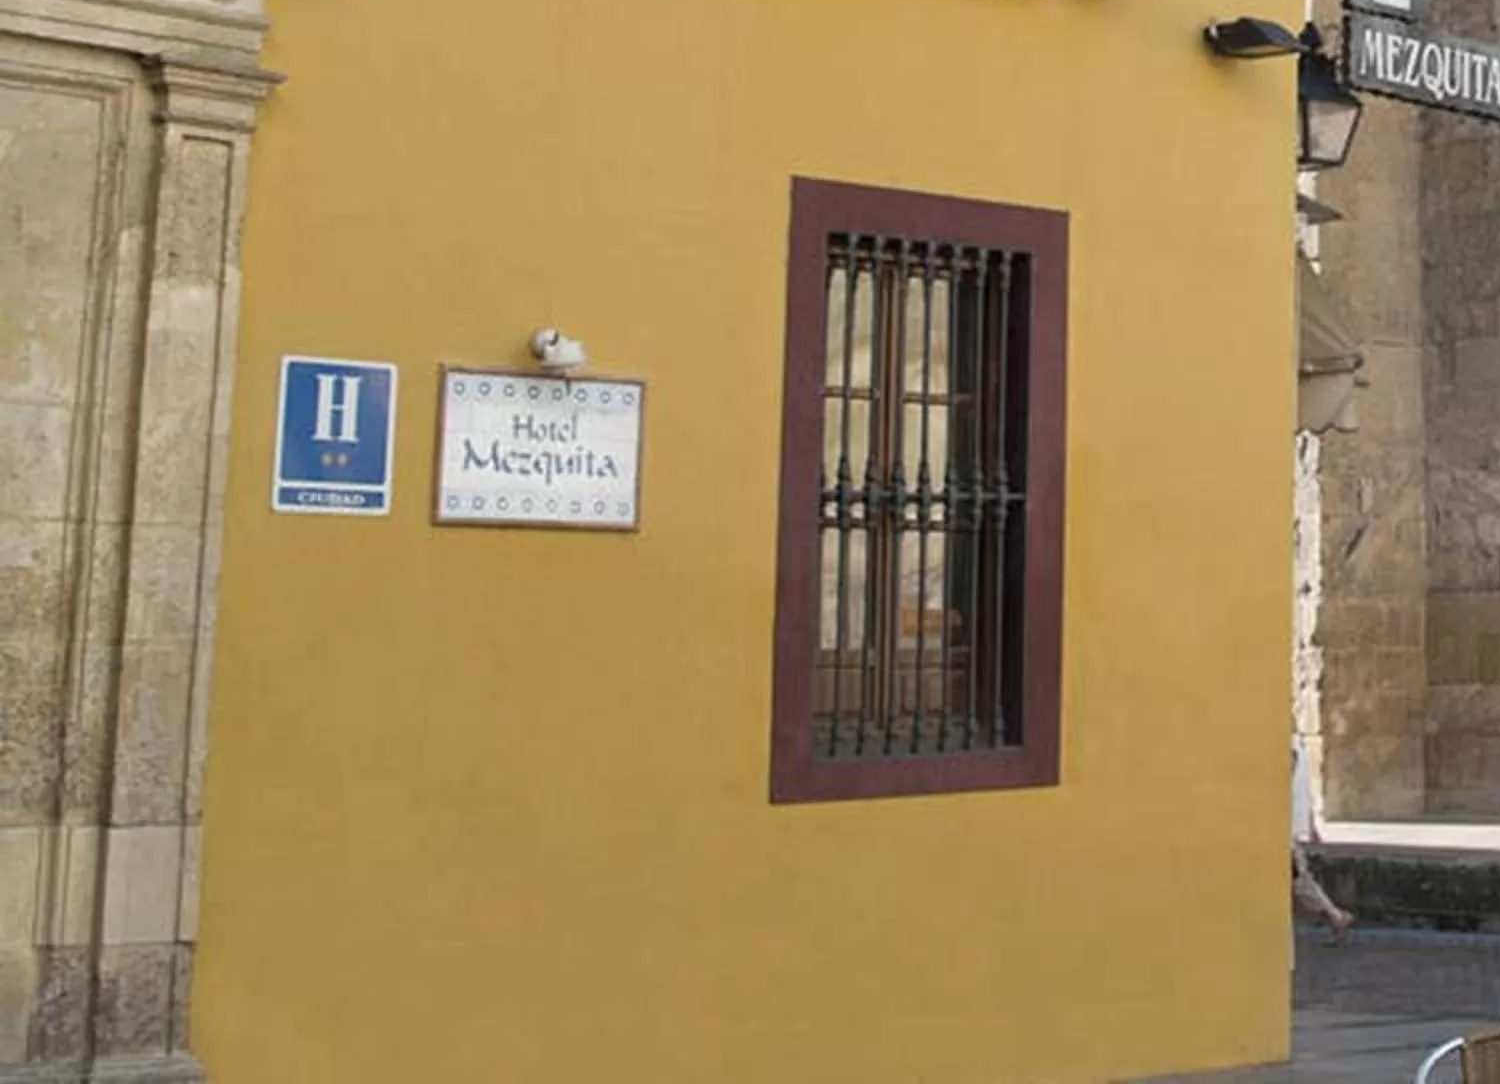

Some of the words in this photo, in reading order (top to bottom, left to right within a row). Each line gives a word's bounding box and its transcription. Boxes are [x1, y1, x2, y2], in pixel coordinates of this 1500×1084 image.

[312, 373, 361, 443] H
[513, 414, 578, 444] Hotel
[463, 438, 618, 483] Mezquita
